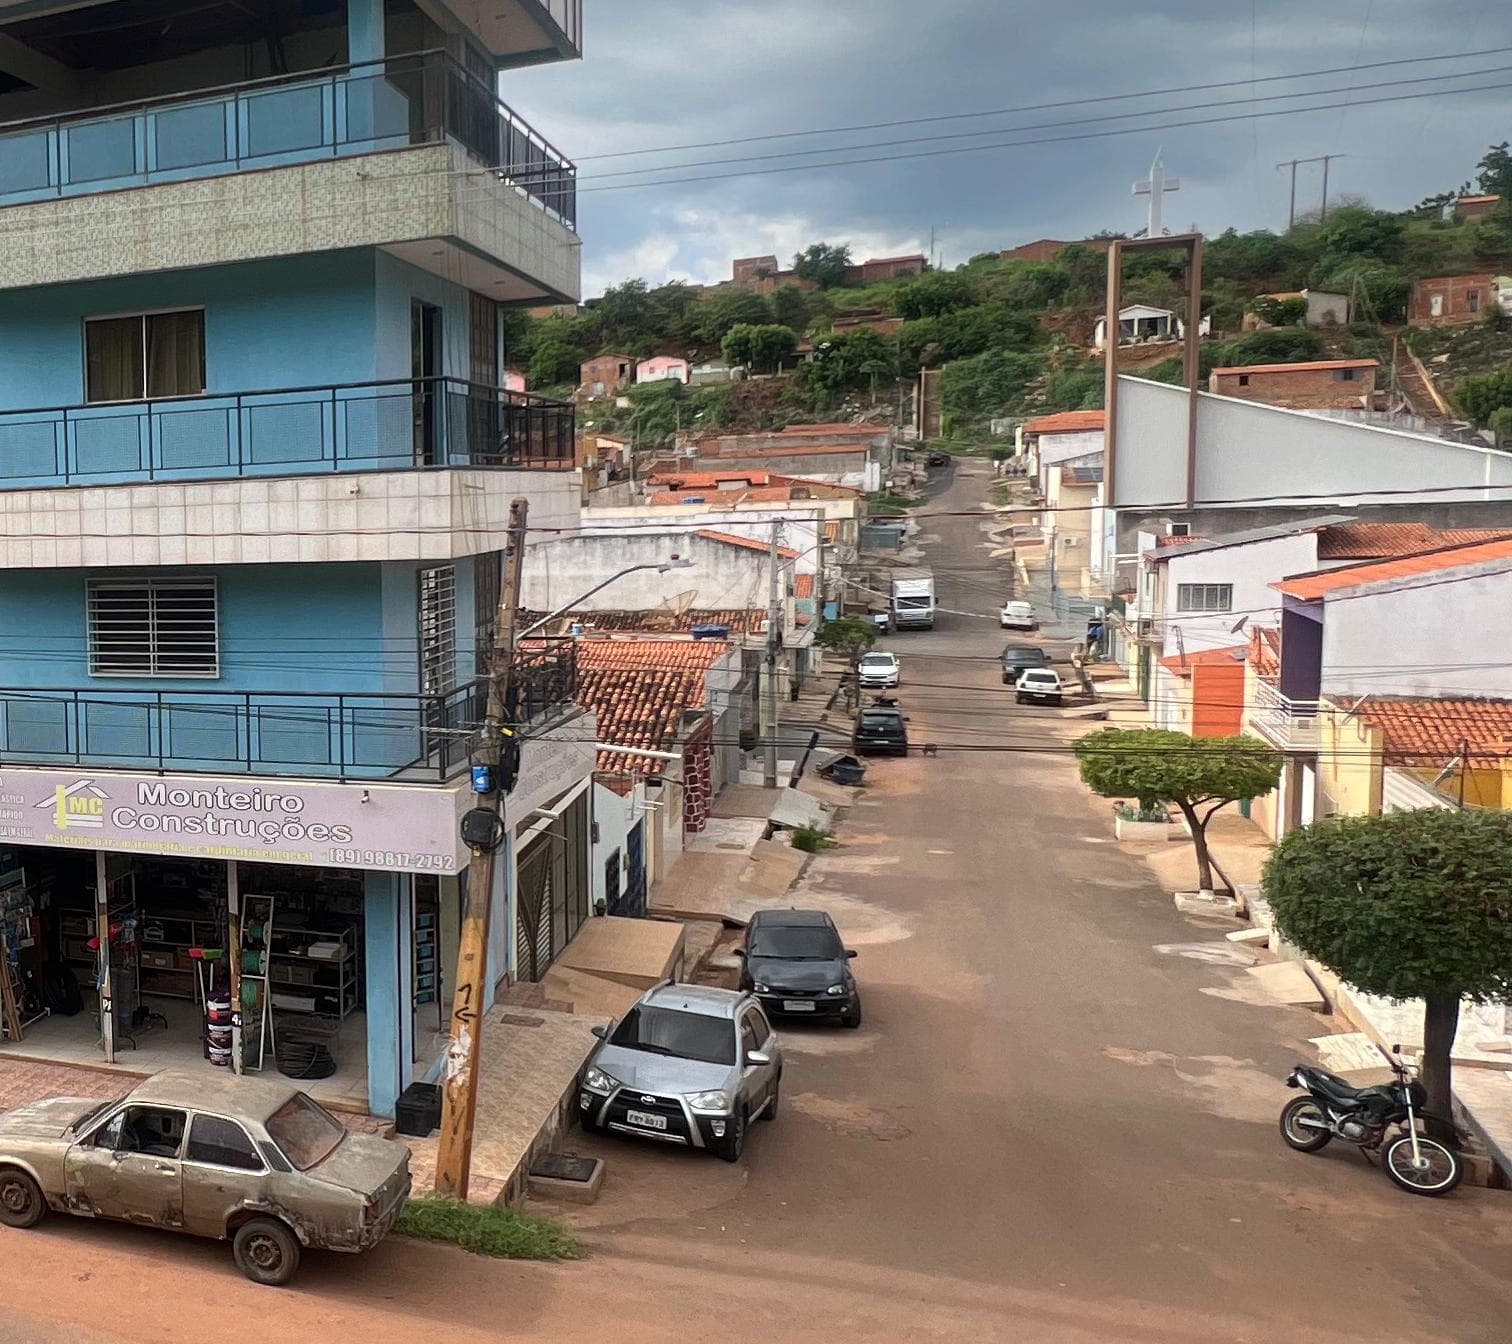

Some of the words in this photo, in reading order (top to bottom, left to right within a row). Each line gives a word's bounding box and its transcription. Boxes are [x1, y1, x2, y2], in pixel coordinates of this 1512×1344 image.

[69, 796, 104, 815] MC
[137, 782, 305, 814] Monteiro
[111, 806, 353, 845] Construções
[329, 847, 361, 864] (89)
